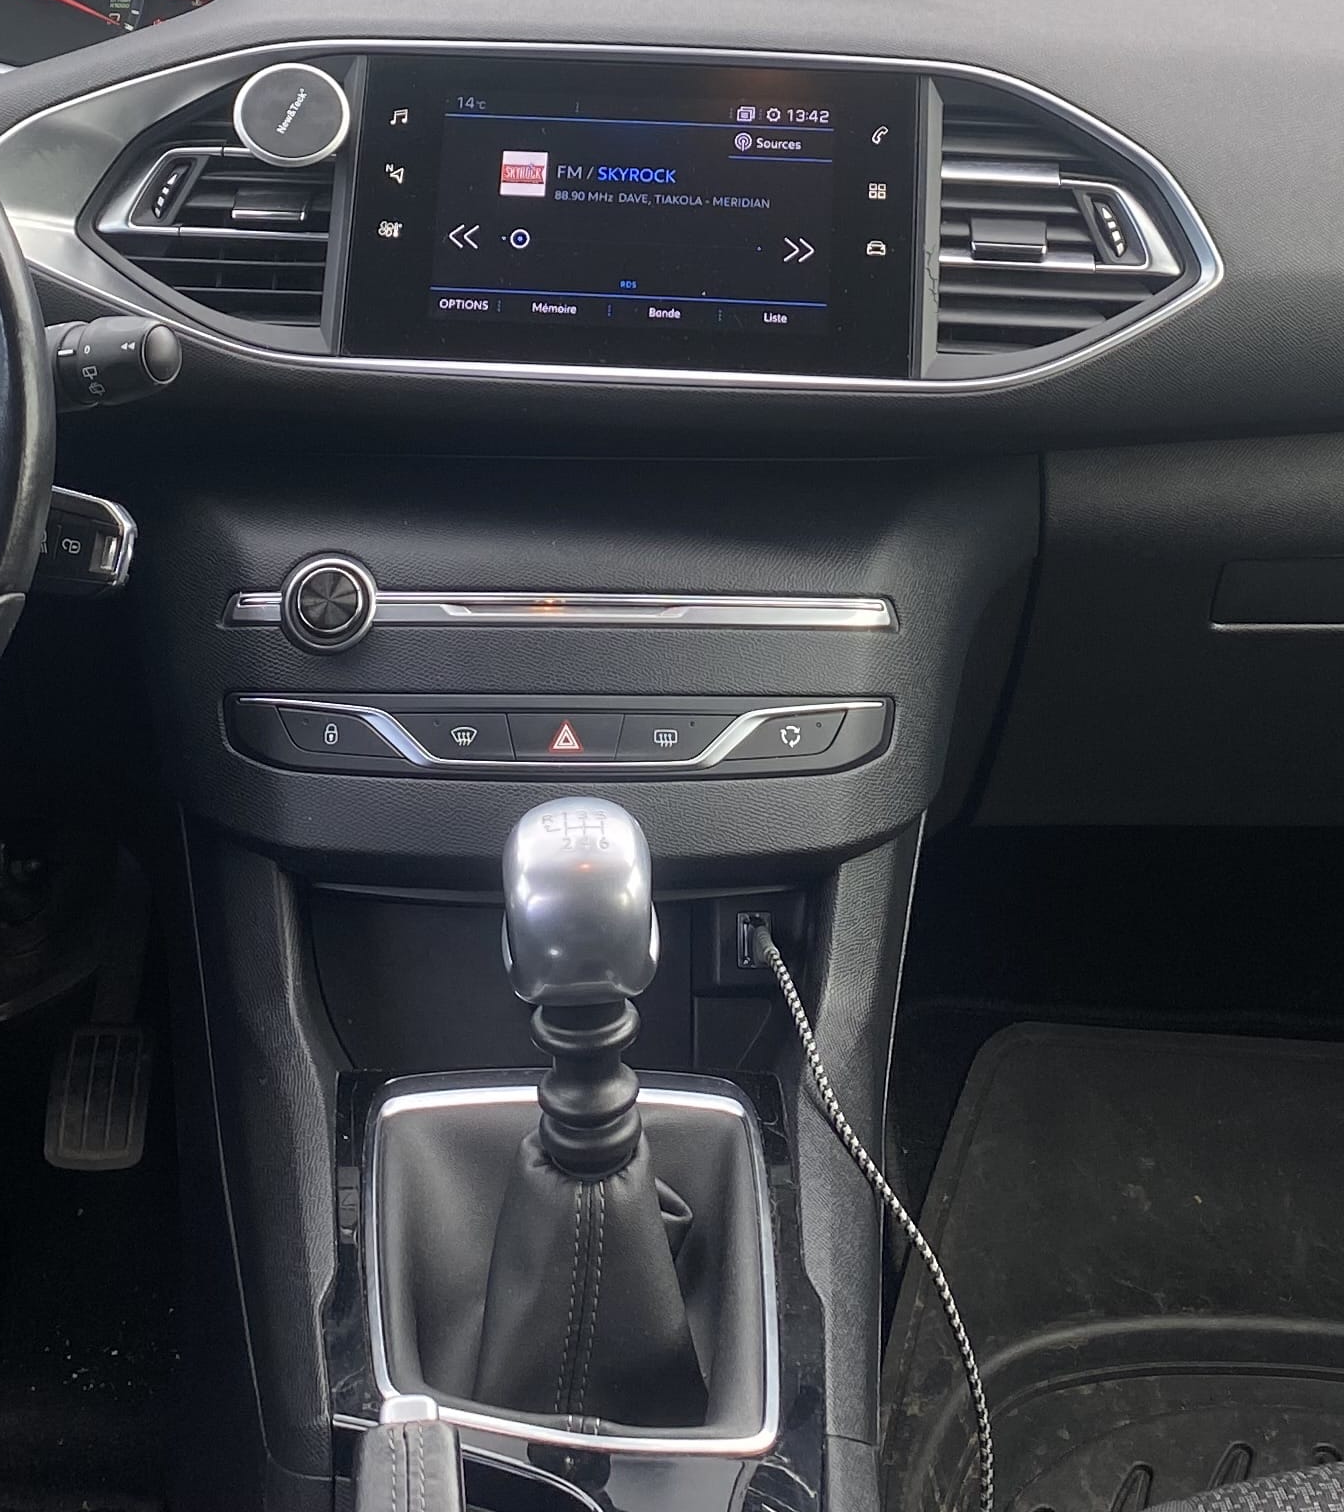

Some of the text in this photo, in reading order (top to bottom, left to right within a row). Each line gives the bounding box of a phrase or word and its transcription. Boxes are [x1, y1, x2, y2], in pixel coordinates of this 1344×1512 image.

[786, 108, 831, 124] 13:42
[755, 137, 803, 151] Sources
[557, 165, 583, 180] FM
[597, 166, 677, 184] SKYROCK
[554, 190, 586, 202] 88.90
[587, 191, 614, 203] MHz
[618, 193, 652, 206] DAVE,
[654, 194, 703, 207] TIAKOLA
[712, 196, 771, 209] MERIDIAN
[439, 298, 490, 311] OPTIONS
[531, 301, 577, 315] Mémoire
[648, 306, 682, 319] Bande
[763, 312, 788, 324] Liste
[599, 836, 611, 850] 6
